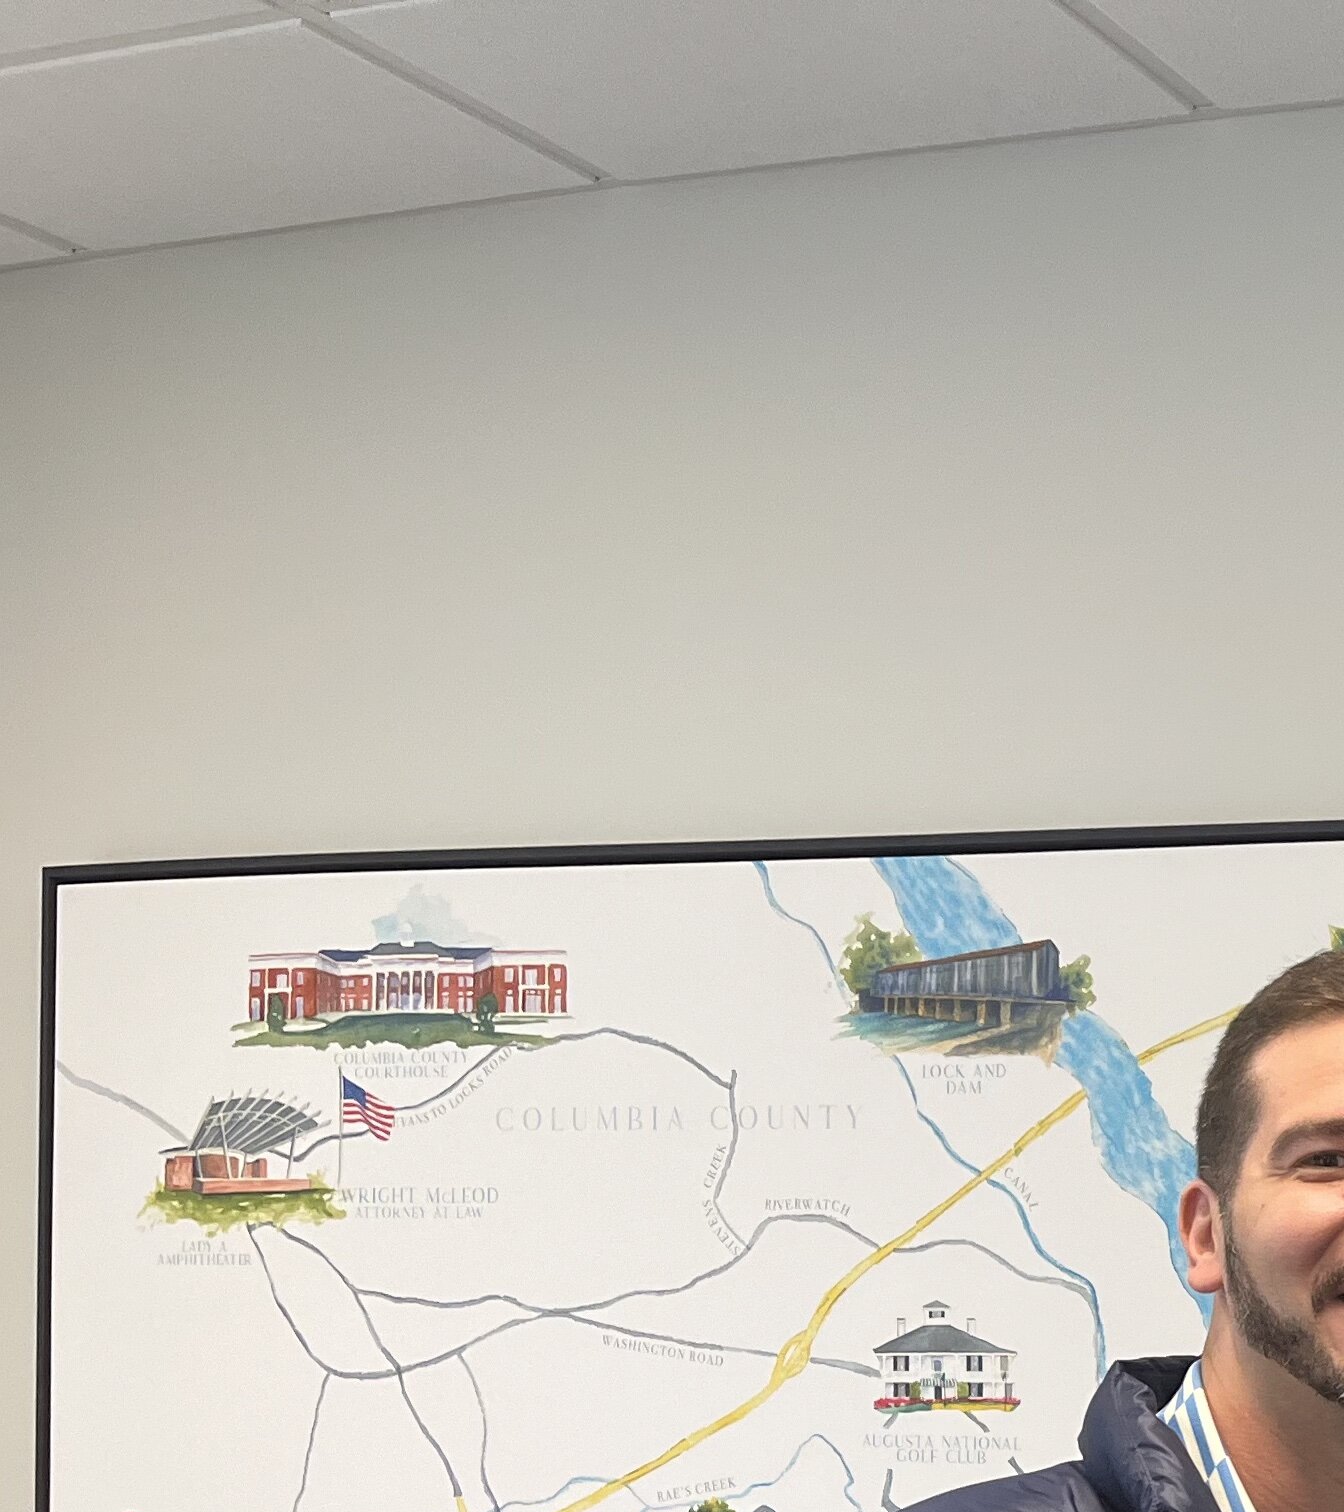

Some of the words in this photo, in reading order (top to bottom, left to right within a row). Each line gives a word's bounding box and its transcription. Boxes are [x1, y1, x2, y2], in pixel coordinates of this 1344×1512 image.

[333, 1051, 405, 1065] COLUMBIA
[411, 1050, 468, 1064] COUNTY
[354, 1064, 449, 1079] COURTHOUSE
[922, 1063, 966, 1079] LOCK
[974, 1063, 1007, 1079] AND
[431, 1105, 448, 1120] TO
[449, 1076, 484, 1109] LOCKS
[483, 1046, 513, 1078] ROAD
[946, 1080, 982, 1095] DAM
[495, 1105, 685, 1132] COLUMBIA
[709, 1103, 864, 1131] COUNTY
[703, 1143, 727, 1189] CREEK
[337, 1187, 416, 1204] WRIGHT
[1004, 1167, 1039, 1212] CANAL
[354, 1206, 427, 1220] ATTORNEY
[432, 1206, 450, 1220] AT
[455, 1206, 485, 1220] LAW
[764, 1198, 851, 1217] RIVERWATCH
[703, 1199, 741, 1256] STEVENS
[181, 1240, 213, 1254] LADY
[156, 1252, 252, 1266] AMPHITHEATER
[602, 1334, 684, 1359] WASHINGTON
[689, 1350, 724, 1367] ROAD
[863, 1433, 934, 1449] AUGUSTA
[942, 1434, 1022, 1451] NATIONAL
[896, 1449, 939, 1464] GOLF
[945, 1450, 987, 1465] CLUB
[656, 1486, 693, 1503] RAE'S
[695, 1476, 737, 1495] CREEK
